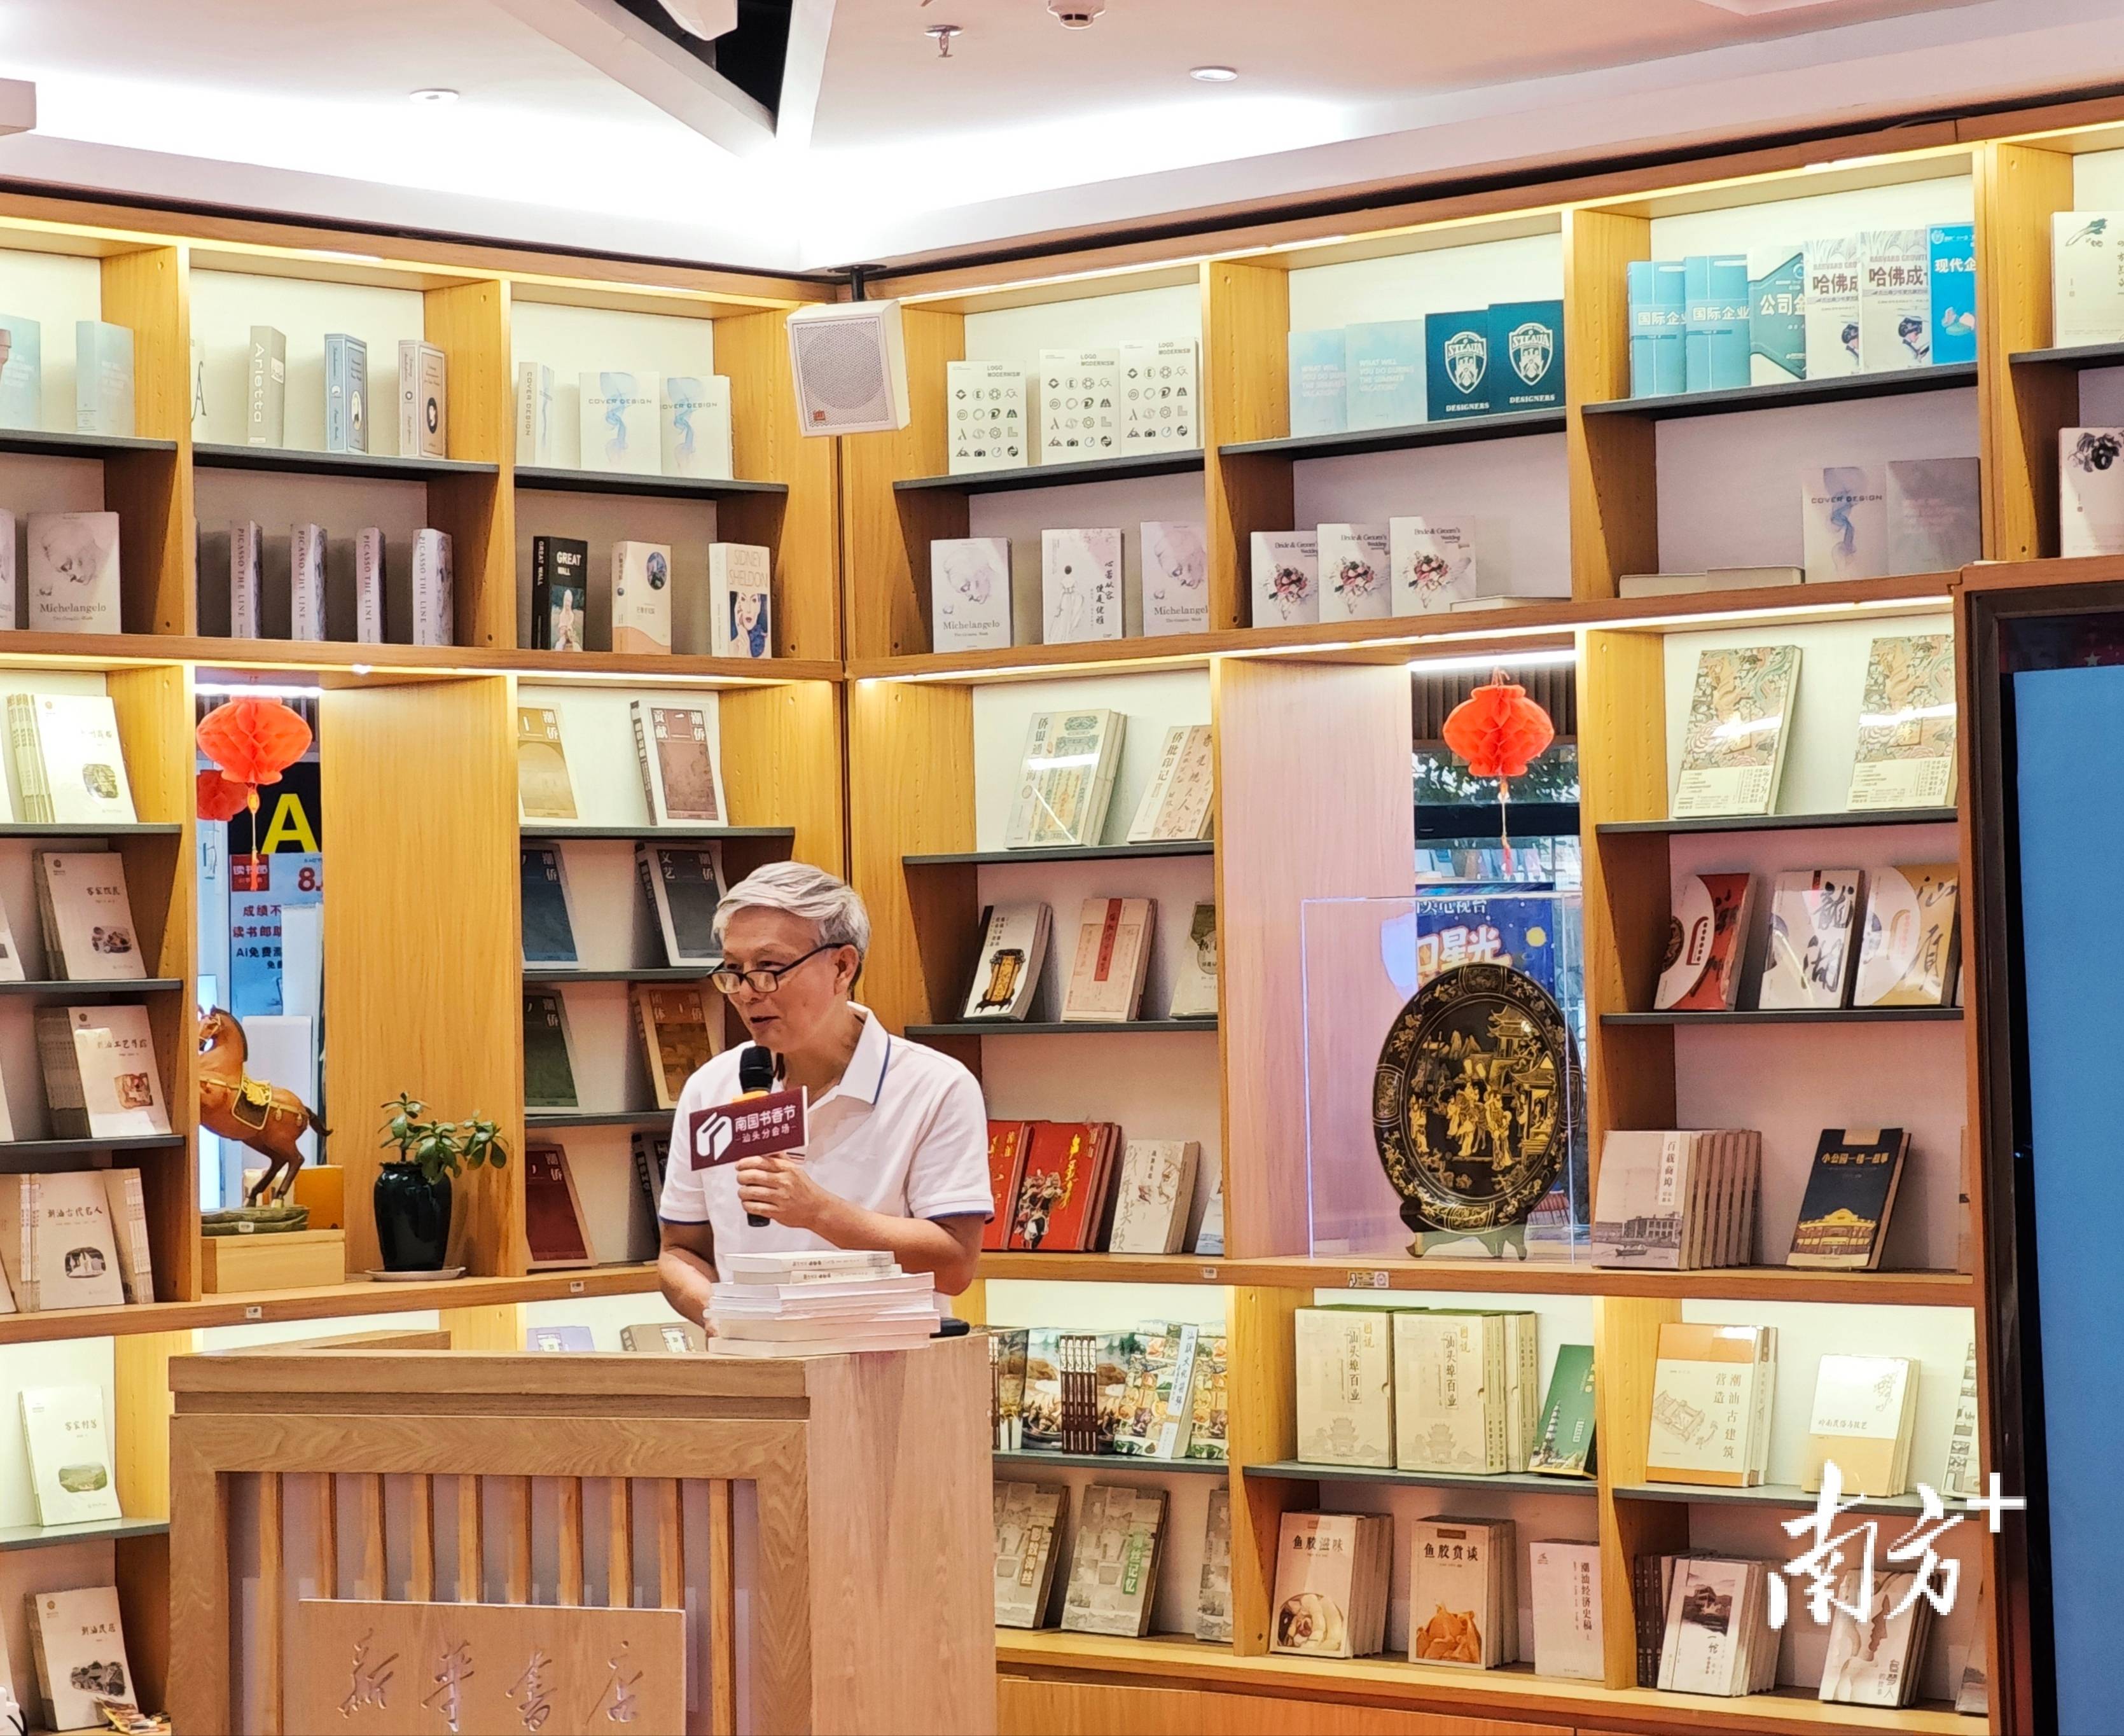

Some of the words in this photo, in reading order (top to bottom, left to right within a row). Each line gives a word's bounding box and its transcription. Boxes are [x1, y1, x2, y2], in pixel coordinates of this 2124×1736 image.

[1869, 265, 1927, 287] 哈佛成
[254, 342, 265, 423] Arletta
[1510, 394, 1555, 403] DESIGNERS
[1446, 402, 1490, 412] DESIGNERS
[1846, 494, 1883, 503] DESIGN
[557, 552, 581, 566] GREAT
[733, 550, 762, 566] SIDNEY
[728, 571, 768, 588] SHELDON
[39, 602, 107, 613] Michelangelo
[1155, 605, 1208, 615] Michelangel
[943, 620, 1000, 630] Michelangelo
[1417, 899, 1487, 915] 头电视台
[735, 1104, 796, 1132] 南国书香节
[742, 1123, 790, 1143] 汕头分会场
[1347, 1331, 1360, 1401] 汕头埠百业
[1444, 1336, 1457, 1407] 汕头埠百业
